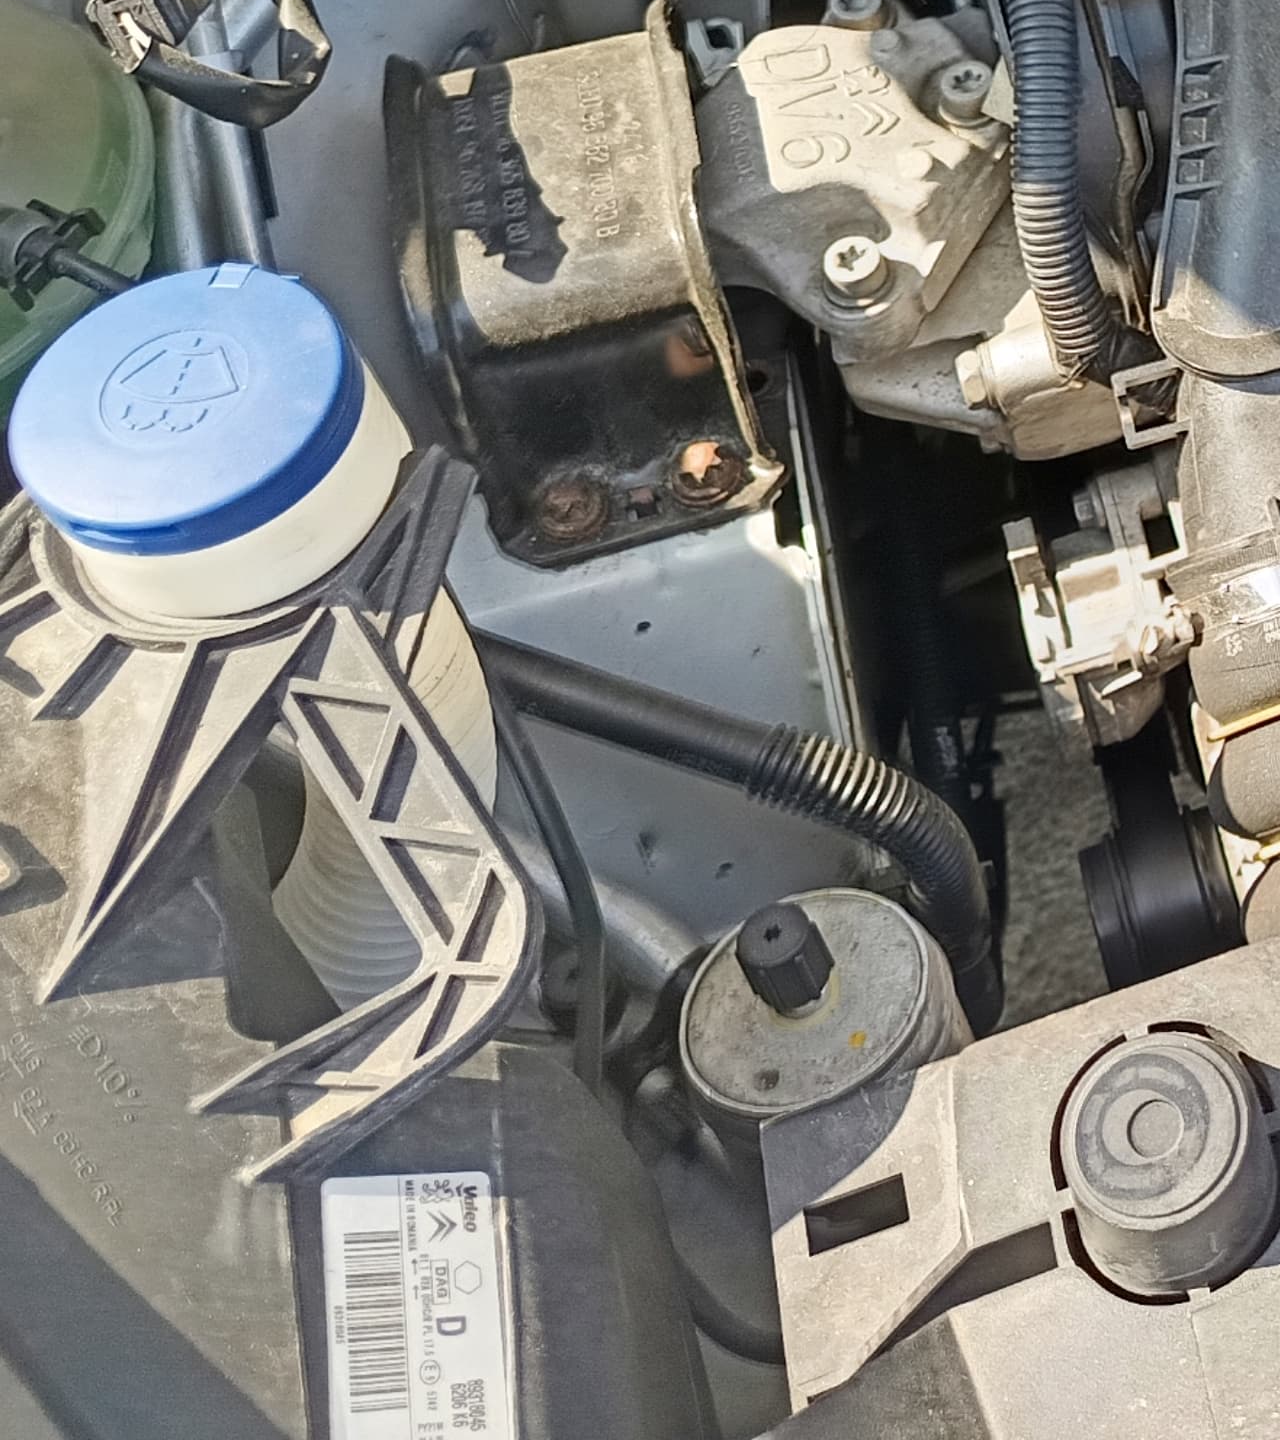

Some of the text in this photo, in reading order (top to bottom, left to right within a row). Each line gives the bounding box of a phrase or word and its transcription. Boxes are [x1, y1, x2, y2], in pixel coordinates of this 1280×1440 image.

[765, 44, 852, 170] DV6
[405, 1179, 418, 1252] MADE IN ROMANIA
[463, 1185, 478, 1233] Valeo
[435, 1266, 448, 1298] DAG
[435, 1314, 467, 1336] D
[452, 1412, 469, 1428] K6
